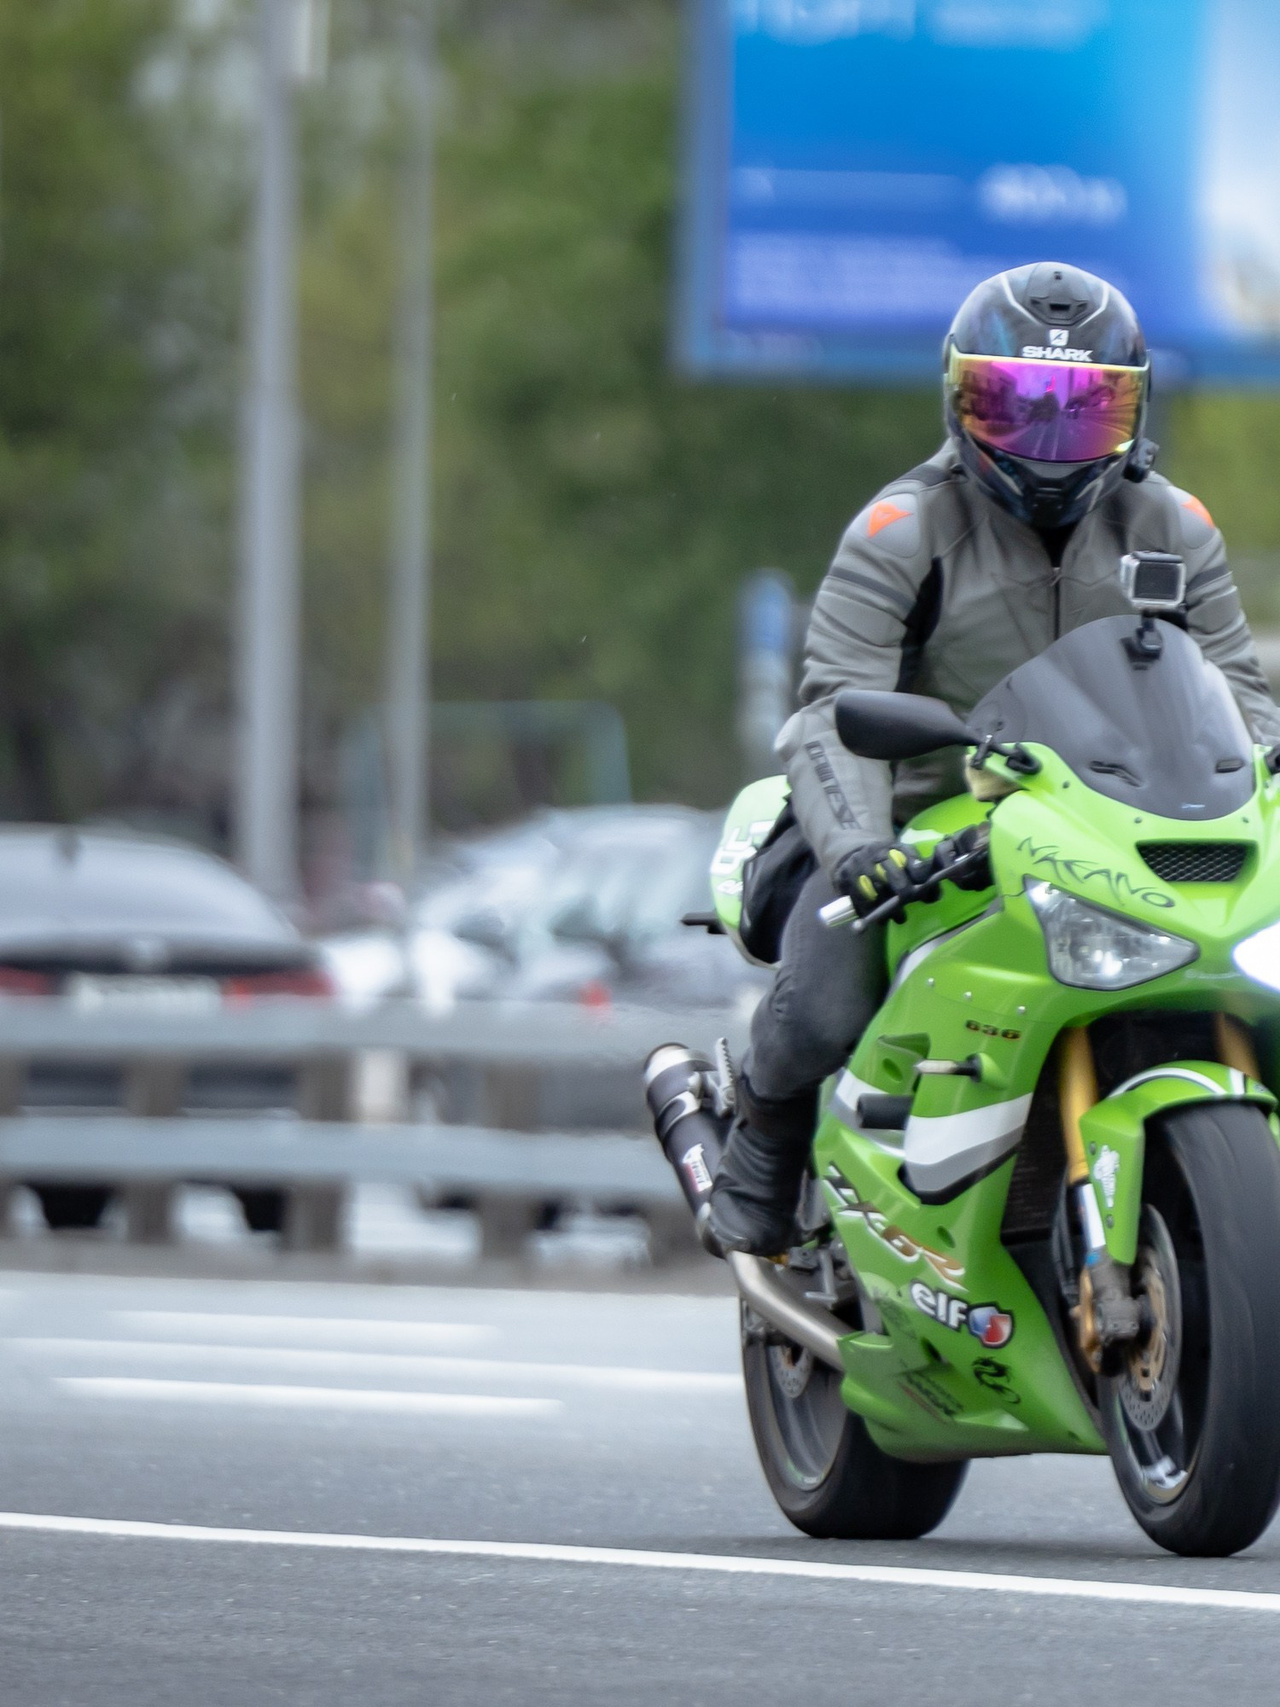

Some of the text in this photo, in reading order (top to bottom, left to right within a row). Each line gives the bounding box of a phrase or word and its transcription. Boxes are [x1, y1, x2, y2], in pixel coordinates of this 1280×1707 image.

[1021, 345, 1093, 363] SHARK
[964, 1019, 1021, 1041] 636
[910, 1281, 969, 1330] elf
